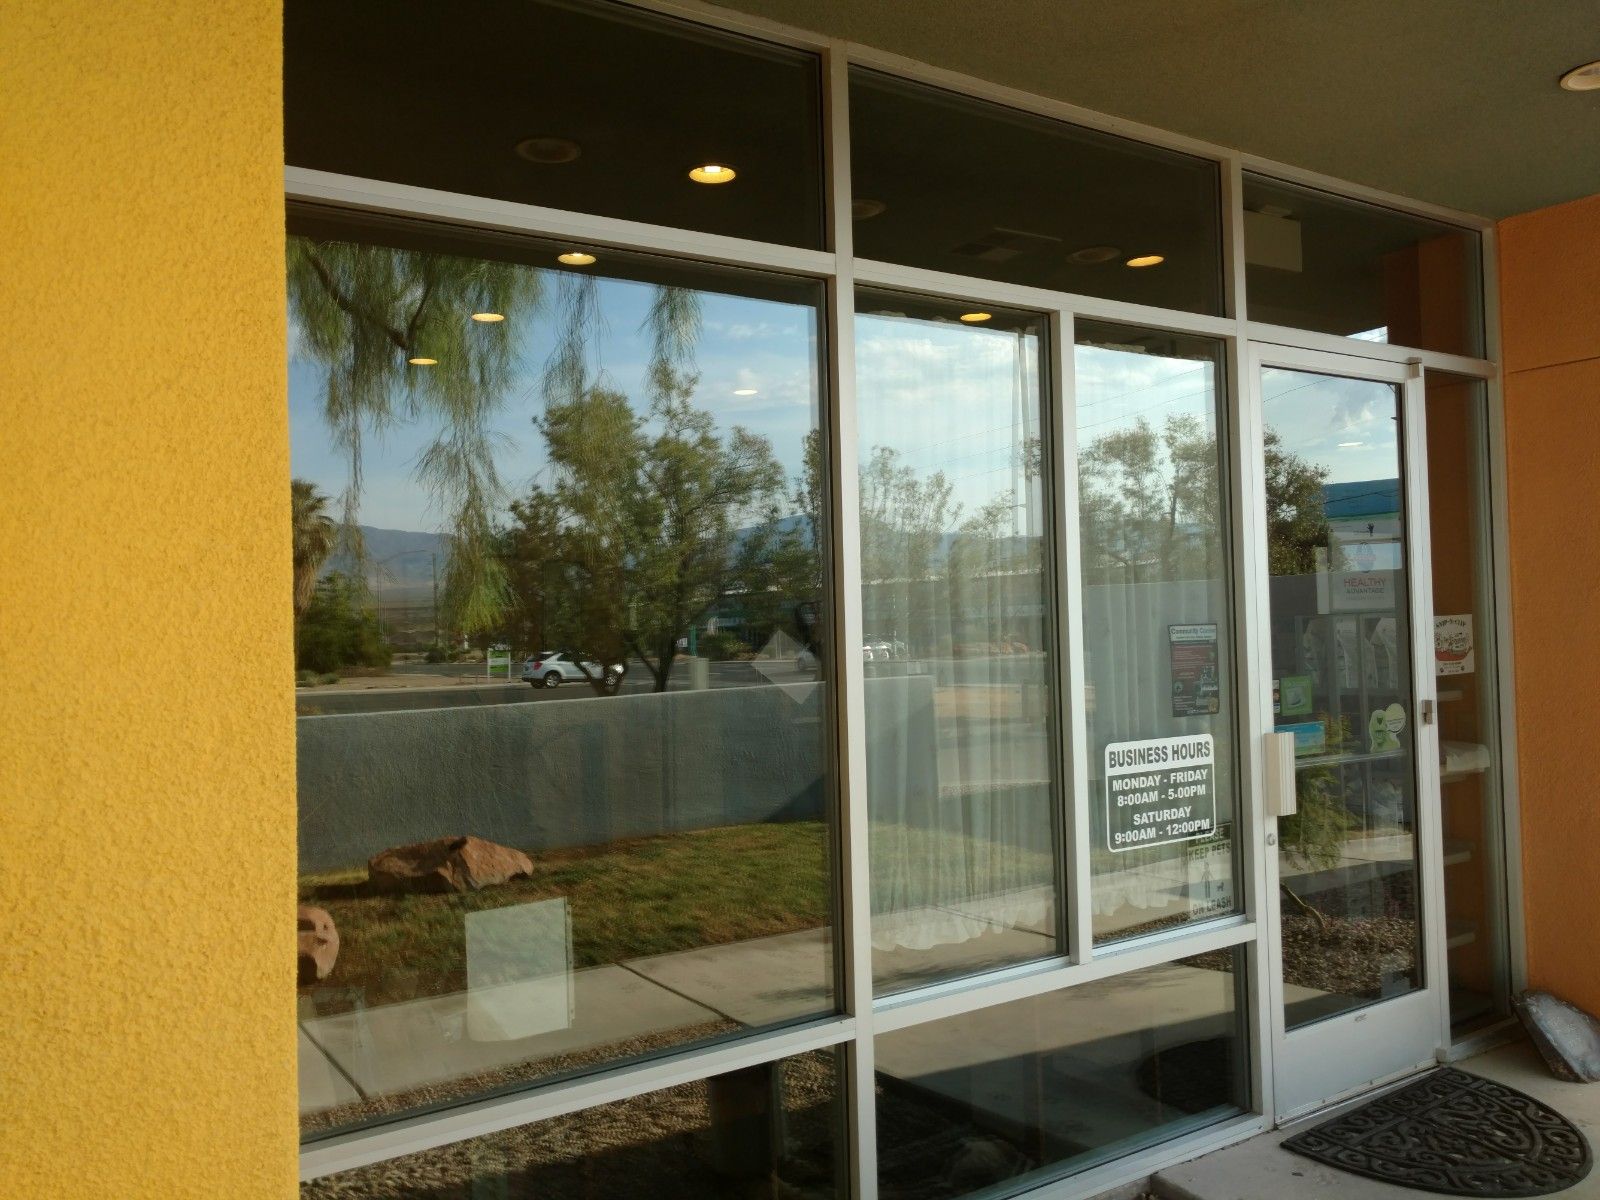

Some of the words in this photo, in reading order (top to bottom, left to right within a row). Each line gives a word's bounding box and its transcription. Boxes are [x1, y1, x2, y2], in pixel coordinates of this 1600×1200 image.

[1343, 576, 1386, 588] HEALTHY
[1109, 745, 1168, 768] BUSINESS
[1172, 741, 1210, 761] HOURS
[1112, 775, 1161, 791] MONDAY
[1170, 769, 1208, 784] FRIDAY
[1117, 791, 1159, 807] 8:00AM
[1133, 806, 1192, 825] SATURDAY
[1115, 827, 1156, 844] 9:00AM
[1166, 819, 1210, 835] 12:00PM
[1188, 846, 1210, 861] KEEP
